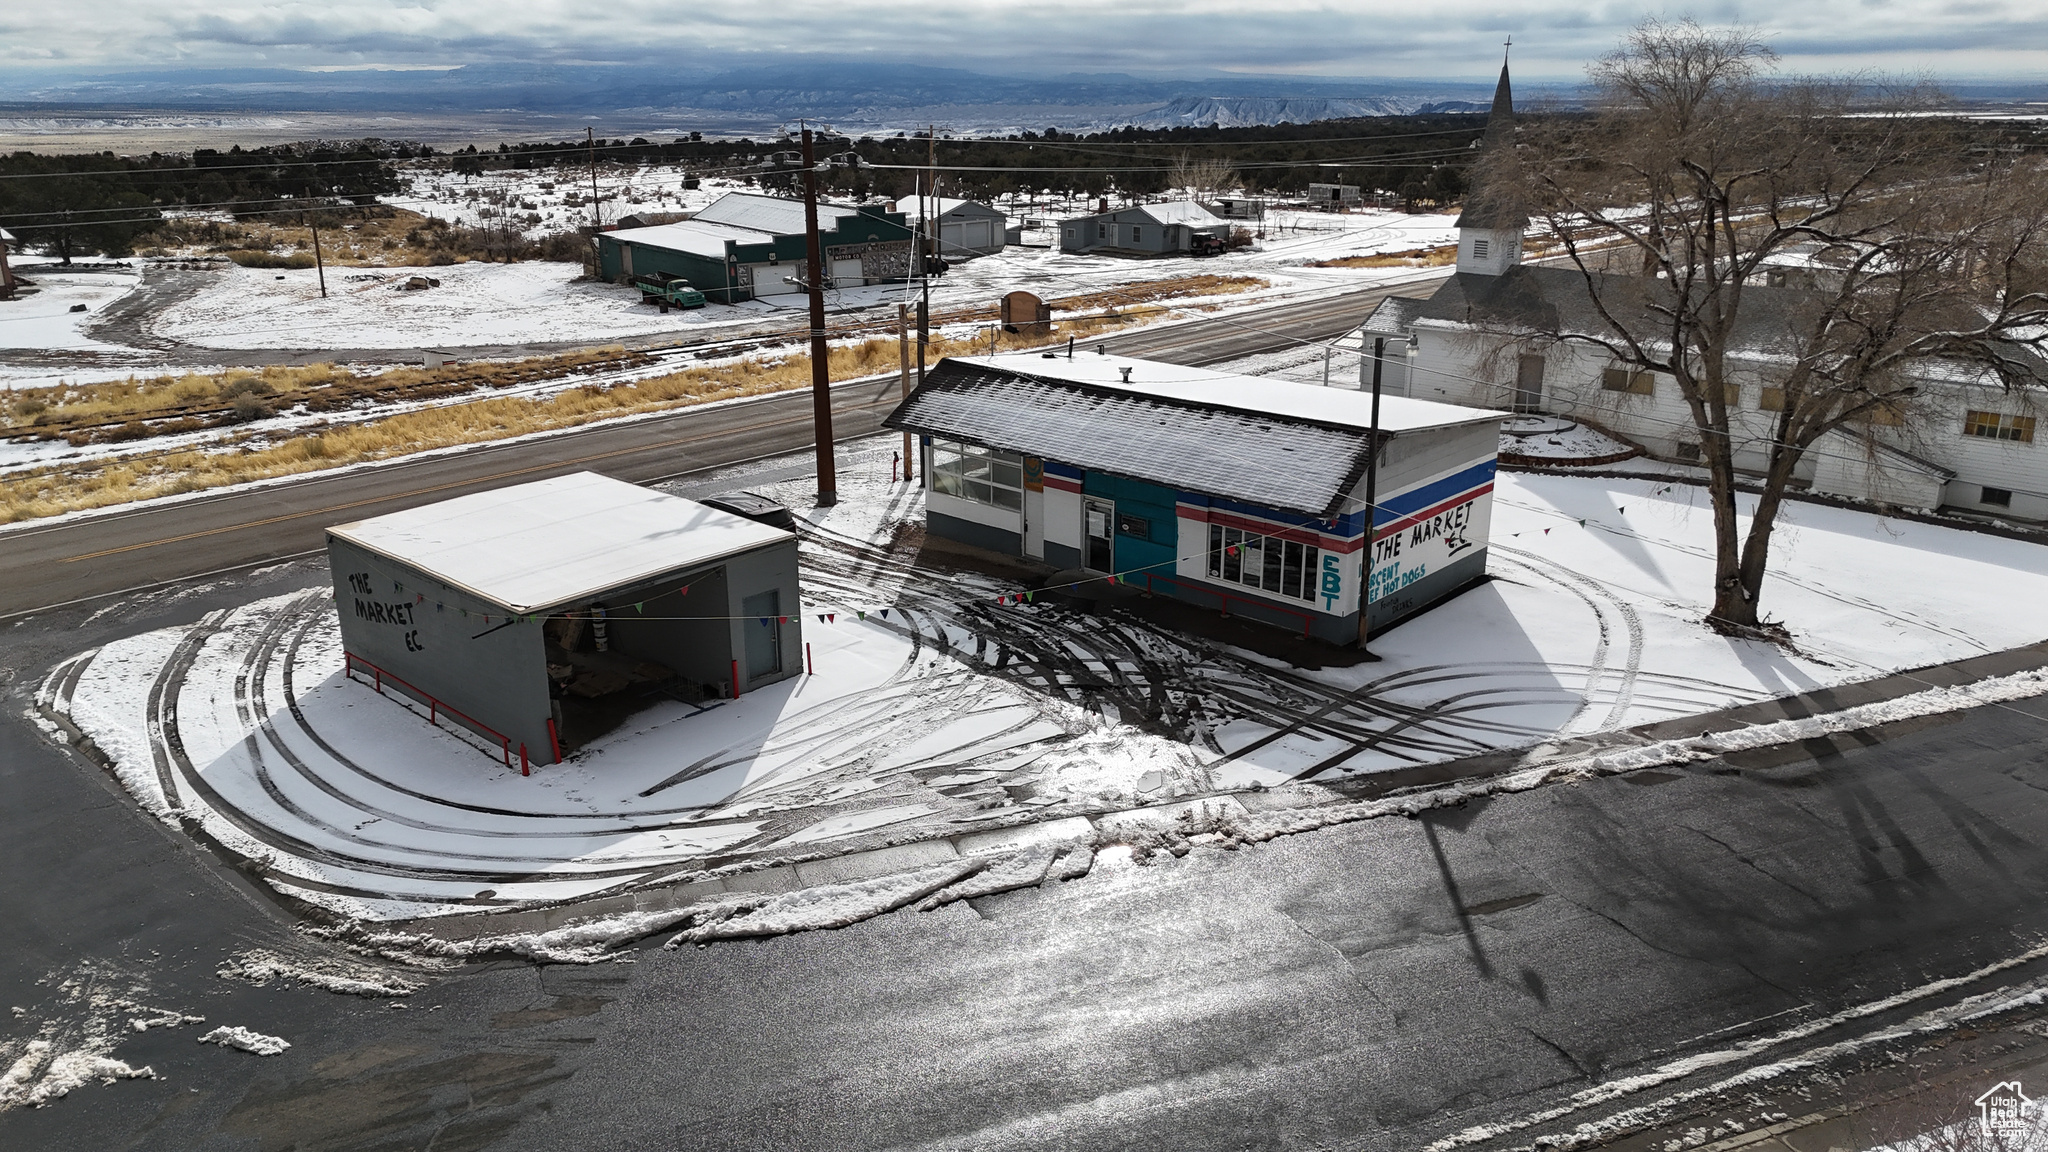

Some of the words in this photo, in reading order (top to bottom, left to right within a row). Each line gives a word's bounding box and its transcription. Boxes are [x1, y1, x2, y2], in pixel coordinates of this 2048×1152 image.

[1376, 533, 1402, 564] THE
[1410, 501, 1473, 548] MARKET
[348, 572, 373, 594] THE
[1320, 555, 1341, 611] EBT
[1382, 577, 1400, 597] HOT
[1401, 563, 1426, 588] DOGS
[355, 597, 414, 626] MARKET
